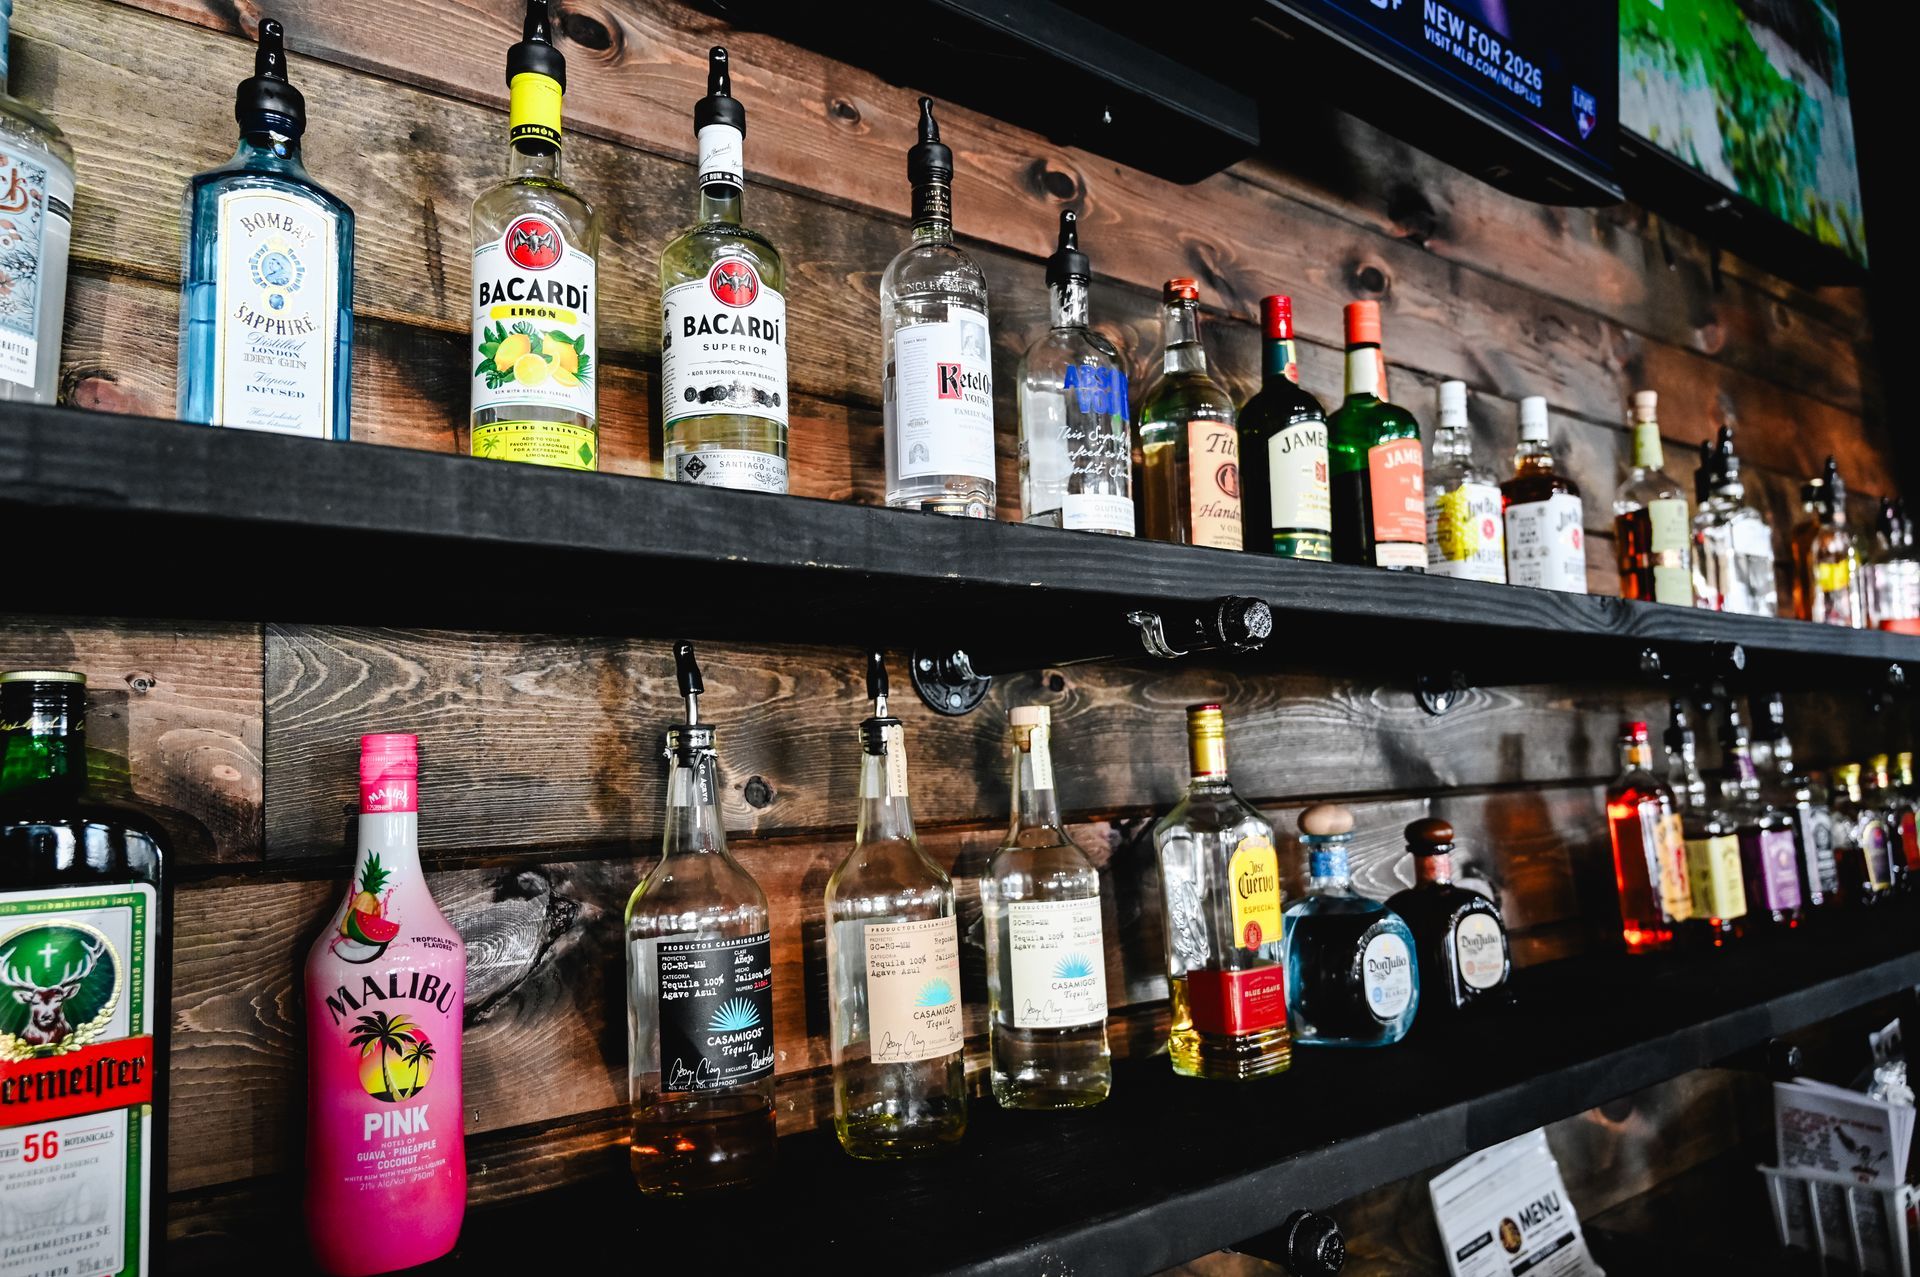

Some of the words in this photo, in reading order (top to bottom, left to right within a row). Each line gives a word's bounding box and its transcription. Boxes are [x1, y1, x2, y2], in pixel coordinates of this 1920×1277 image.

[1424, 24, 1451, 52] VISIT
[1424, 0, 1465, 41] NEW
[1468, 26, 1501, 65] FOR
[1504, 50, 1543, 91] 2026
[521, 126, 554, 139] LIMÓN
[709, 172, 723, 181] RUM
[239, 212, 316, 248] BOMBAY
[479, 277, 590, 315] BACARDÍ
[233, 302, 317, 336] SAPPHIRE
[510, 307, 556, 319] LIMÓN
[683, 313, 780, 345] BACARDÍ
[0, 338, 29, 356] RAFTED
[246, 331, 307, 351] Distilled
[252, 346, 300, 358] LONDON
[703, 343, 768, 356] SUPERIOR
[243, 353, 276, 365] DRY
[278, 358, 307, 370] GIN
[940, 366, 982, 397] Ketel
[246, 385, 305, 398] INFUSED
[1057, 425, 1085, 440] This
[719, 461, 765, 471] SANTIAGO
[1238, 872, 1274, 899] Cuervo
[1244, 905, 1275, 914] ESPECIAL
[871, 925, 916, 933] PRODUCTOS
[411, 936, 444, 945] TROPICAL
[663, 943, 712, 952] PRODUCTOS
[716, 936, 755, 948] CASAMIGOS
[1013, 935, 1044, 943] Tequila
[423, 942, 453, 952] FLAVORED
[870, 960, 906, 969] Tequila
[910, 954, 927, 965] 100%
[870, 969, 897, 978] Agave
[901, 967, 921, 976] Azul
[662, 979, 700, 990] Tequila
[704, 973, 725, 987] 100%
[1052, 978, 1096, 990] CASAMIGOS
[662, 990, 690, 1001] Agave
[694, 988, 718, 998] Azul
[1244, 988, 1261, 998] BLUE
[1262, 984, 1280, 994] AGAVE
[325, 972, 457, 1026] MALIBU
[914, 1005, 956, 1020] CASAMIGOS
[707, 1029, 763, 1047] CASAMIGOS
[722, 1042, 753, 1058] Tequila
[364, 1104, 430, 1141] PINK
[23, 1130, 59, 1163] 56
[64, 1130, 115, 1148] BOTANICALS
[357, 1150, 386, 1162] GUAVA
[394, 1139, 437, 1157] PINEAPPLE
[377, 1155, 418, 1170] COCONUT
[1518, 1190, 1561, 1232] MENU
